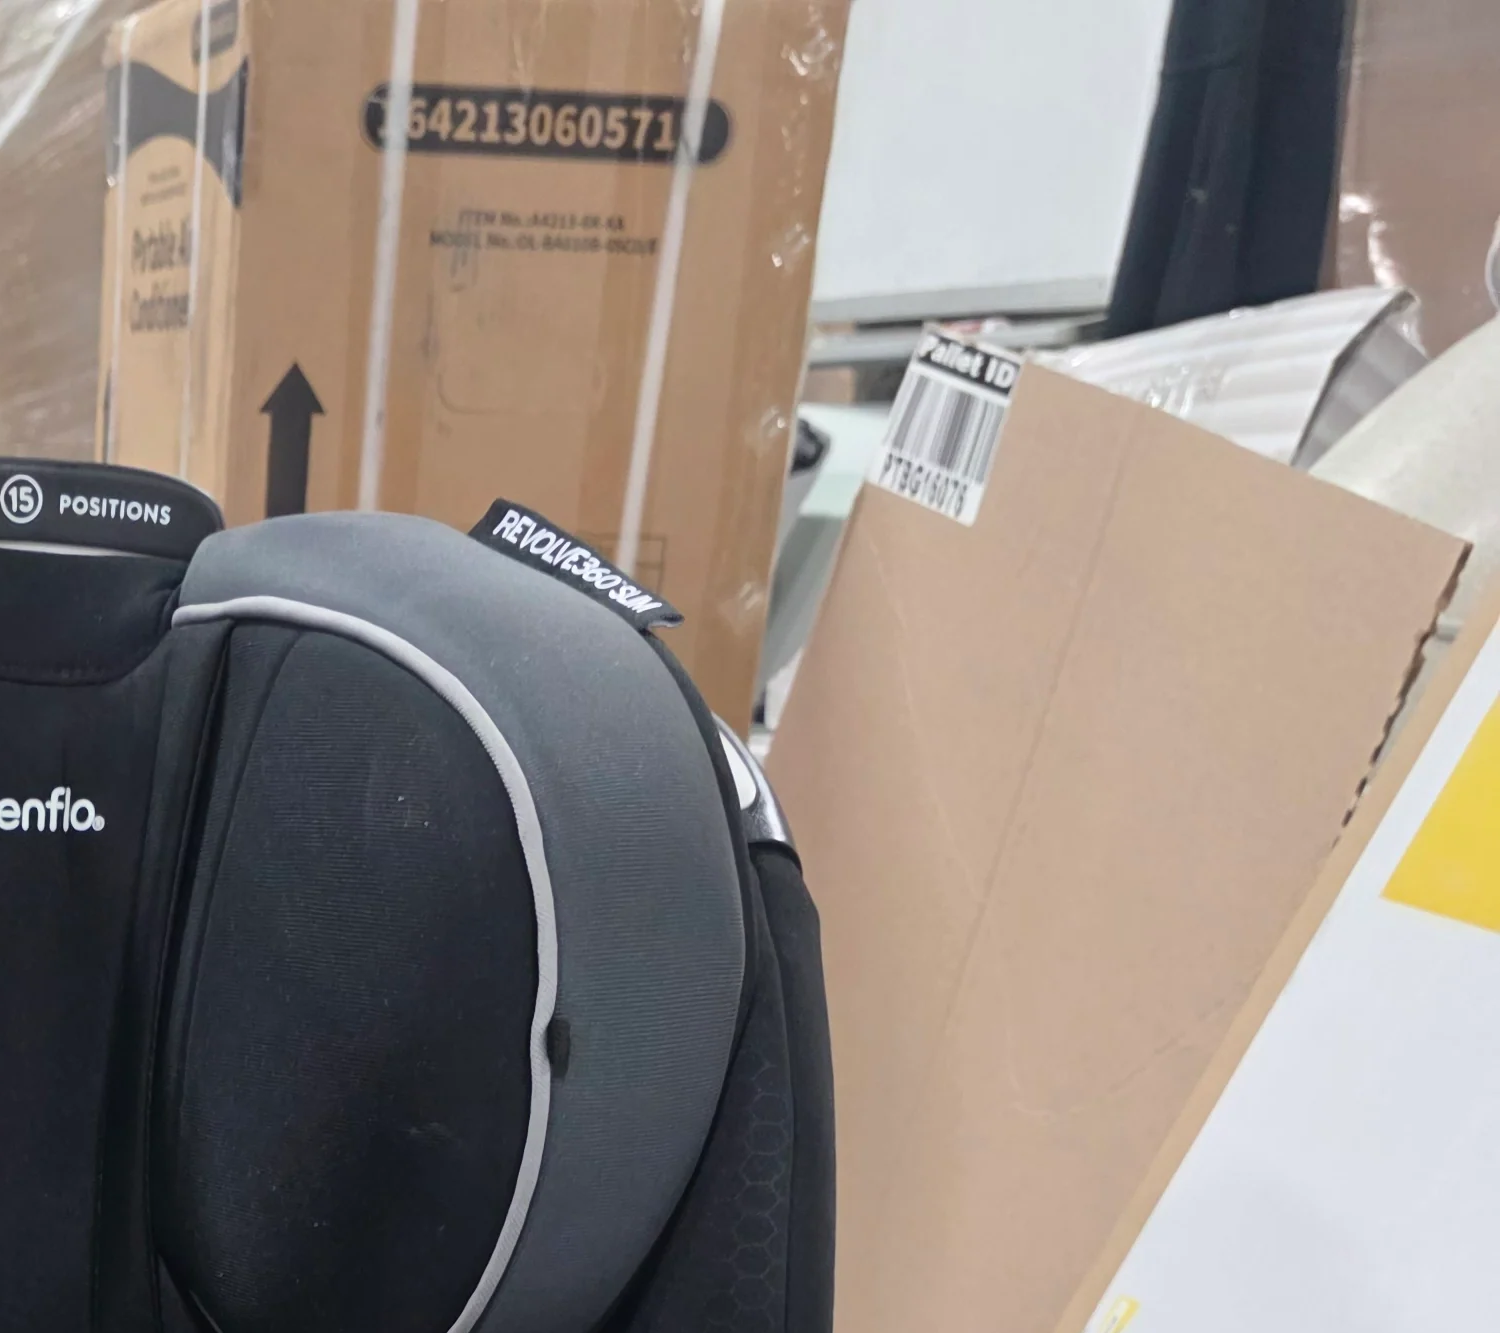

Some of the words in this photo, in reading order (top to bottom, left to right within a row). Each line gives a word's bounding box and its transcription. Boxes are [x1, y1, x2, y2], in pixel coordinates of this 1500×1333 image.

[917, 335, 984, 378] Pallet
[984, 357, 1016, 389] ID
[8, 486, 33, 514] 15
[59, 494, 171, 526] POSITIONS
[608, 584, 663, 614] SLIM
